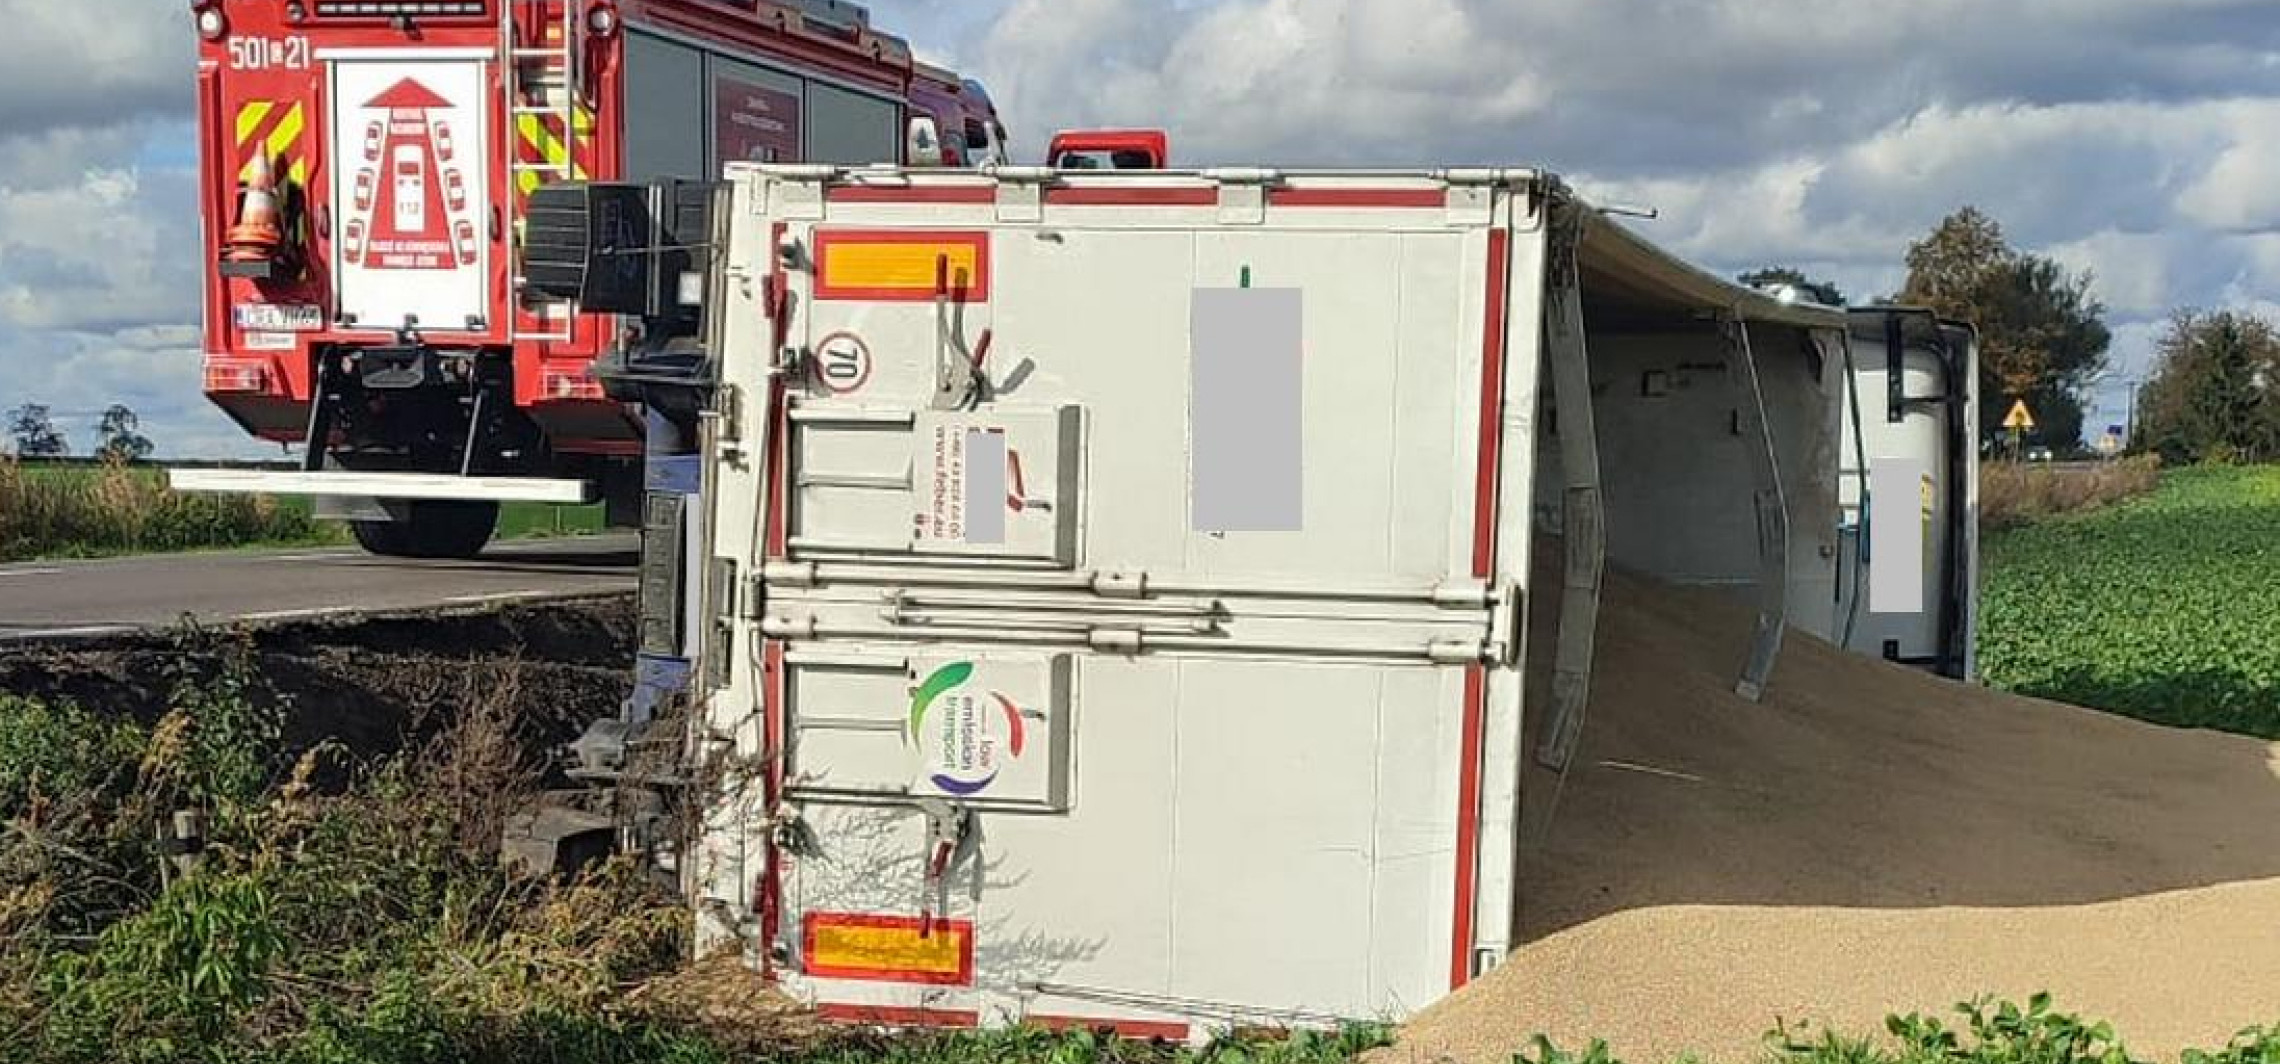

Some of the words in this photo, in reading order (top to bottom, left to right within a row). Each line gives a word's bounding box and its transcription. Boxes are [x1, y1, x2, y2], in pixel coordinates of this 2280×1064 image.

[228, 36, 268, 69] 501
[284, 36, 309, 69] 21
[826, 348, 857, 379] 70
[943, 695, 958, 769] transport
[961, 695, 976, 771] emission
[980, 740, 994, 767] low
